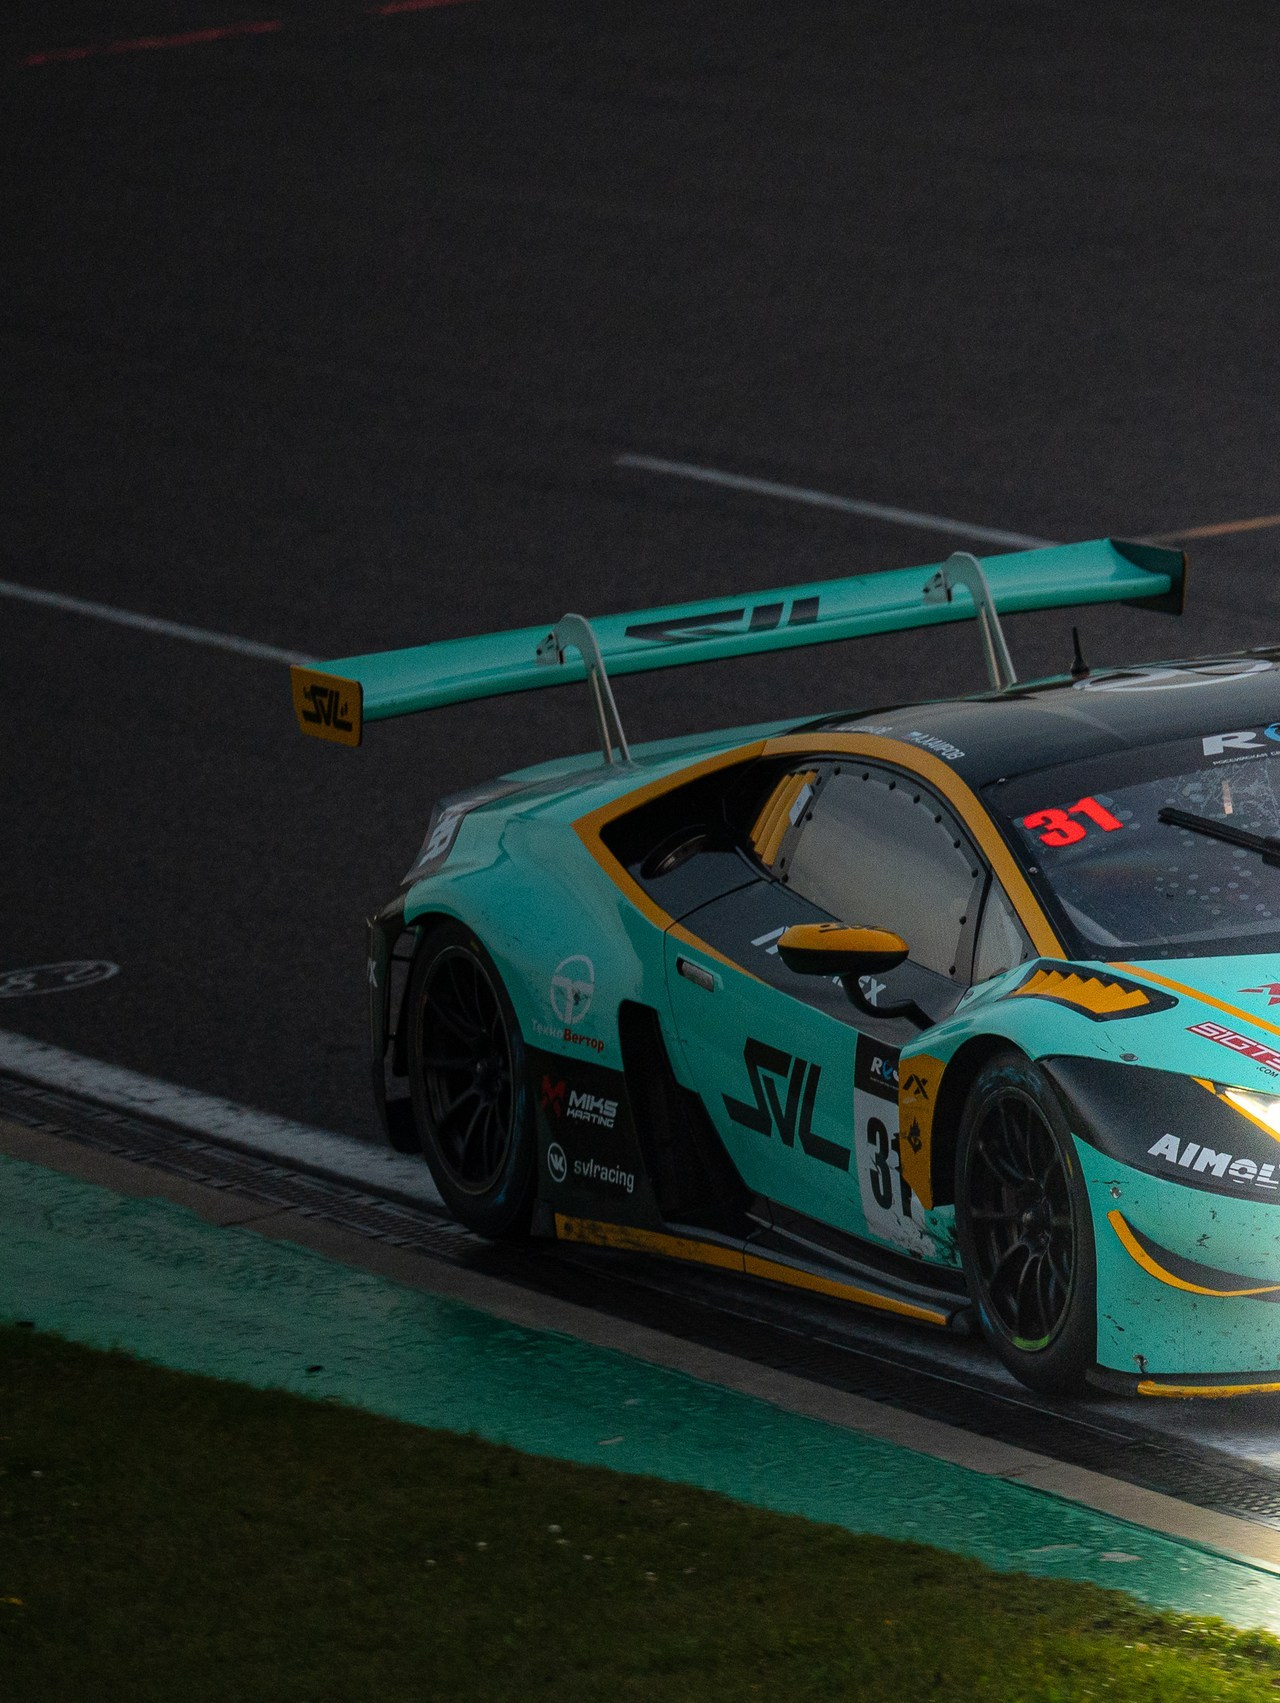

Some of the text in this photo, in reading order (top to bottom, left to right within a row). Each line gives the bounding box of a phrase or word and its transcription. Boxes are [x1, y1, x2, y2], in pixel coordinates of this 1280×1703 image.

[302, 684, 353, 732] SVL
[1023, 796, 1124, 848] 31
[566, 1107, 615, 1129] KARTING
[568, 1089, 619, 1118] MIKS
[722, 1037, 851, 1173] SVL
[573, 1158, 635, 1194] svlracing
[1147, 1133, 1280, 1191] AIMOL
